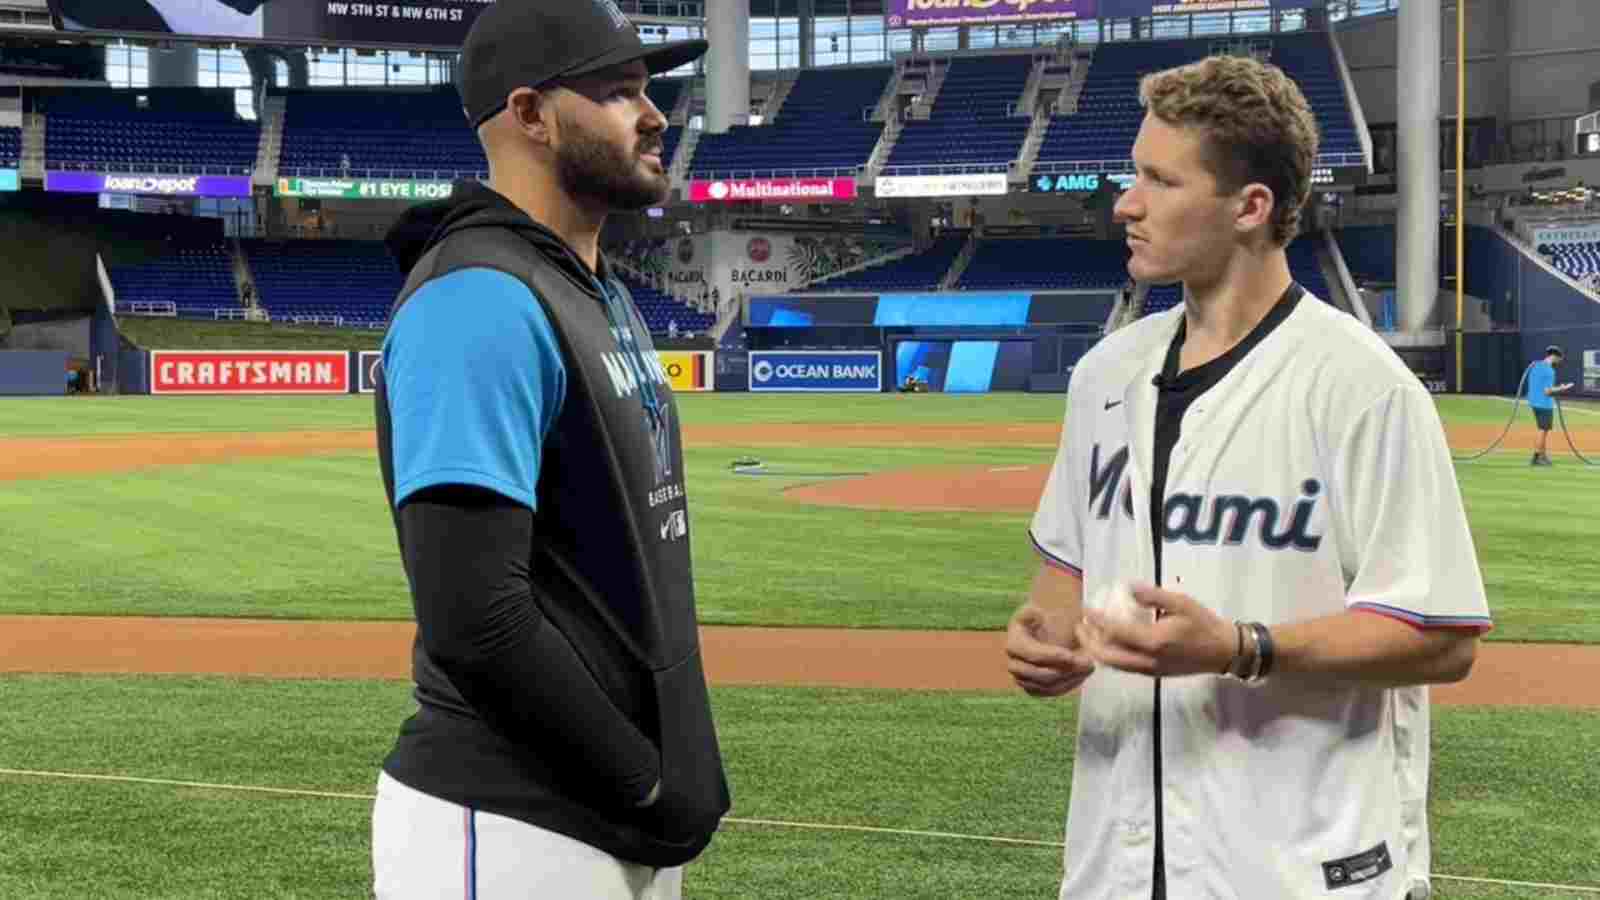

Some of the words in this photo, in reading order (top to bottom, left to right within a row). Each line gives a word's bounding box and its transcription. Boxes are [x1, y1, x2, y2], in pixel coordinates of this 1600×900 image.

[328, 2, 348, 15] NW
[375, 4, 389, 17] ST
[402, 7, 423, 19] NW
[449, 9, 463, 21] ST
[105, 175, 196, 192] loanDepot
[731, 181, 834, 197] Multinational
[1055, 174, 1098, 190] AMG
[380, 184, 409, 197] EYE
[160, 361, 333, 385] CRAFTSMAN
[775, 364, 829, 379] OCEAN
[833, 364, 875, 379] BANK
